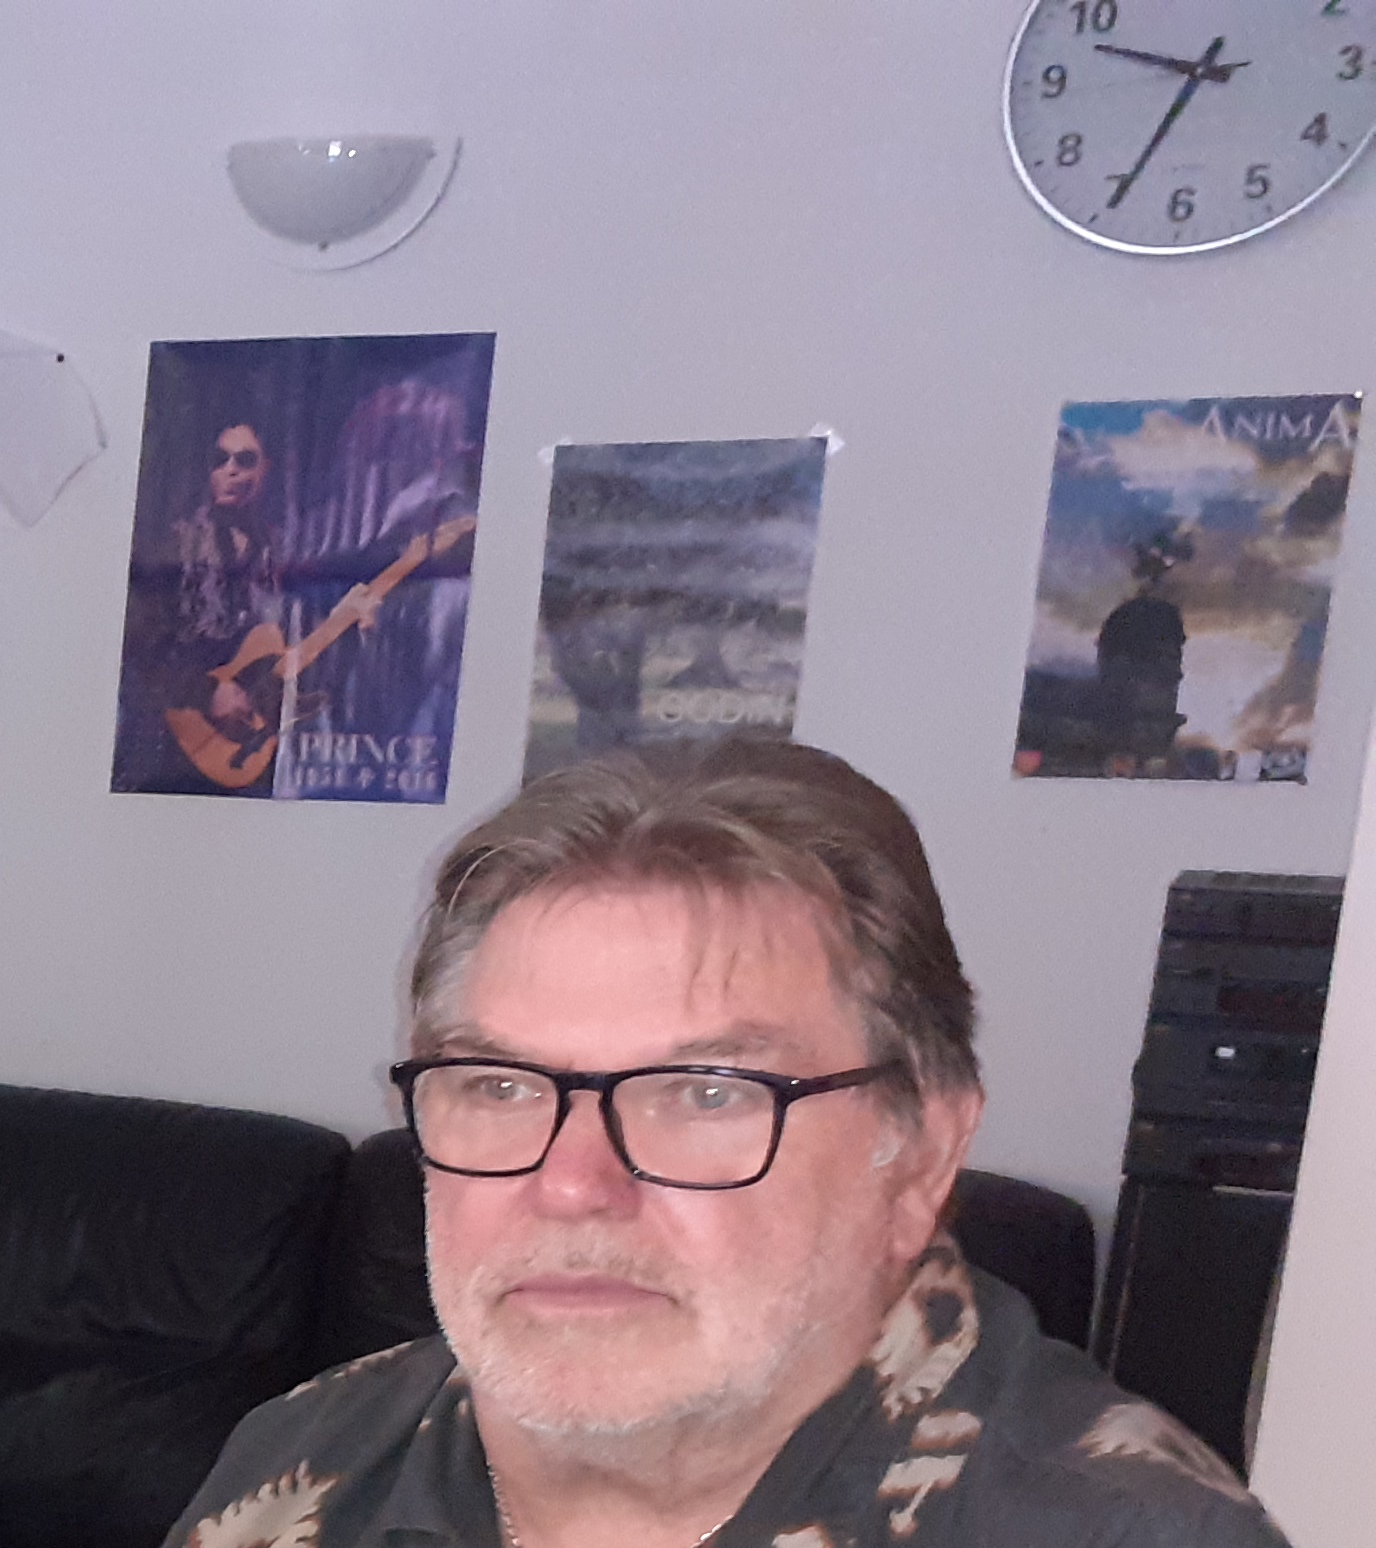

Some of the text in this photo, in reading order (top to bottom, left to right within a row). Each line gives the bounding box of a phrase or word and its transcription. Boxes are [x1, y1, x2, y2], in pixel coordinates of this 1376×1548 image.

[1070, 0, 1117, 33] 10
[1337, 44, 1364, 80] 3
[1042, 64, 1067, 98] 9
[1300, 112, 1329, 146] 4
[1057, 132, 1083, 167] 8
[1244, 163, 1271, 199] 5
[1168, 185, 1197, 223] 6
[298, 732, 439, 765] PRINCE
